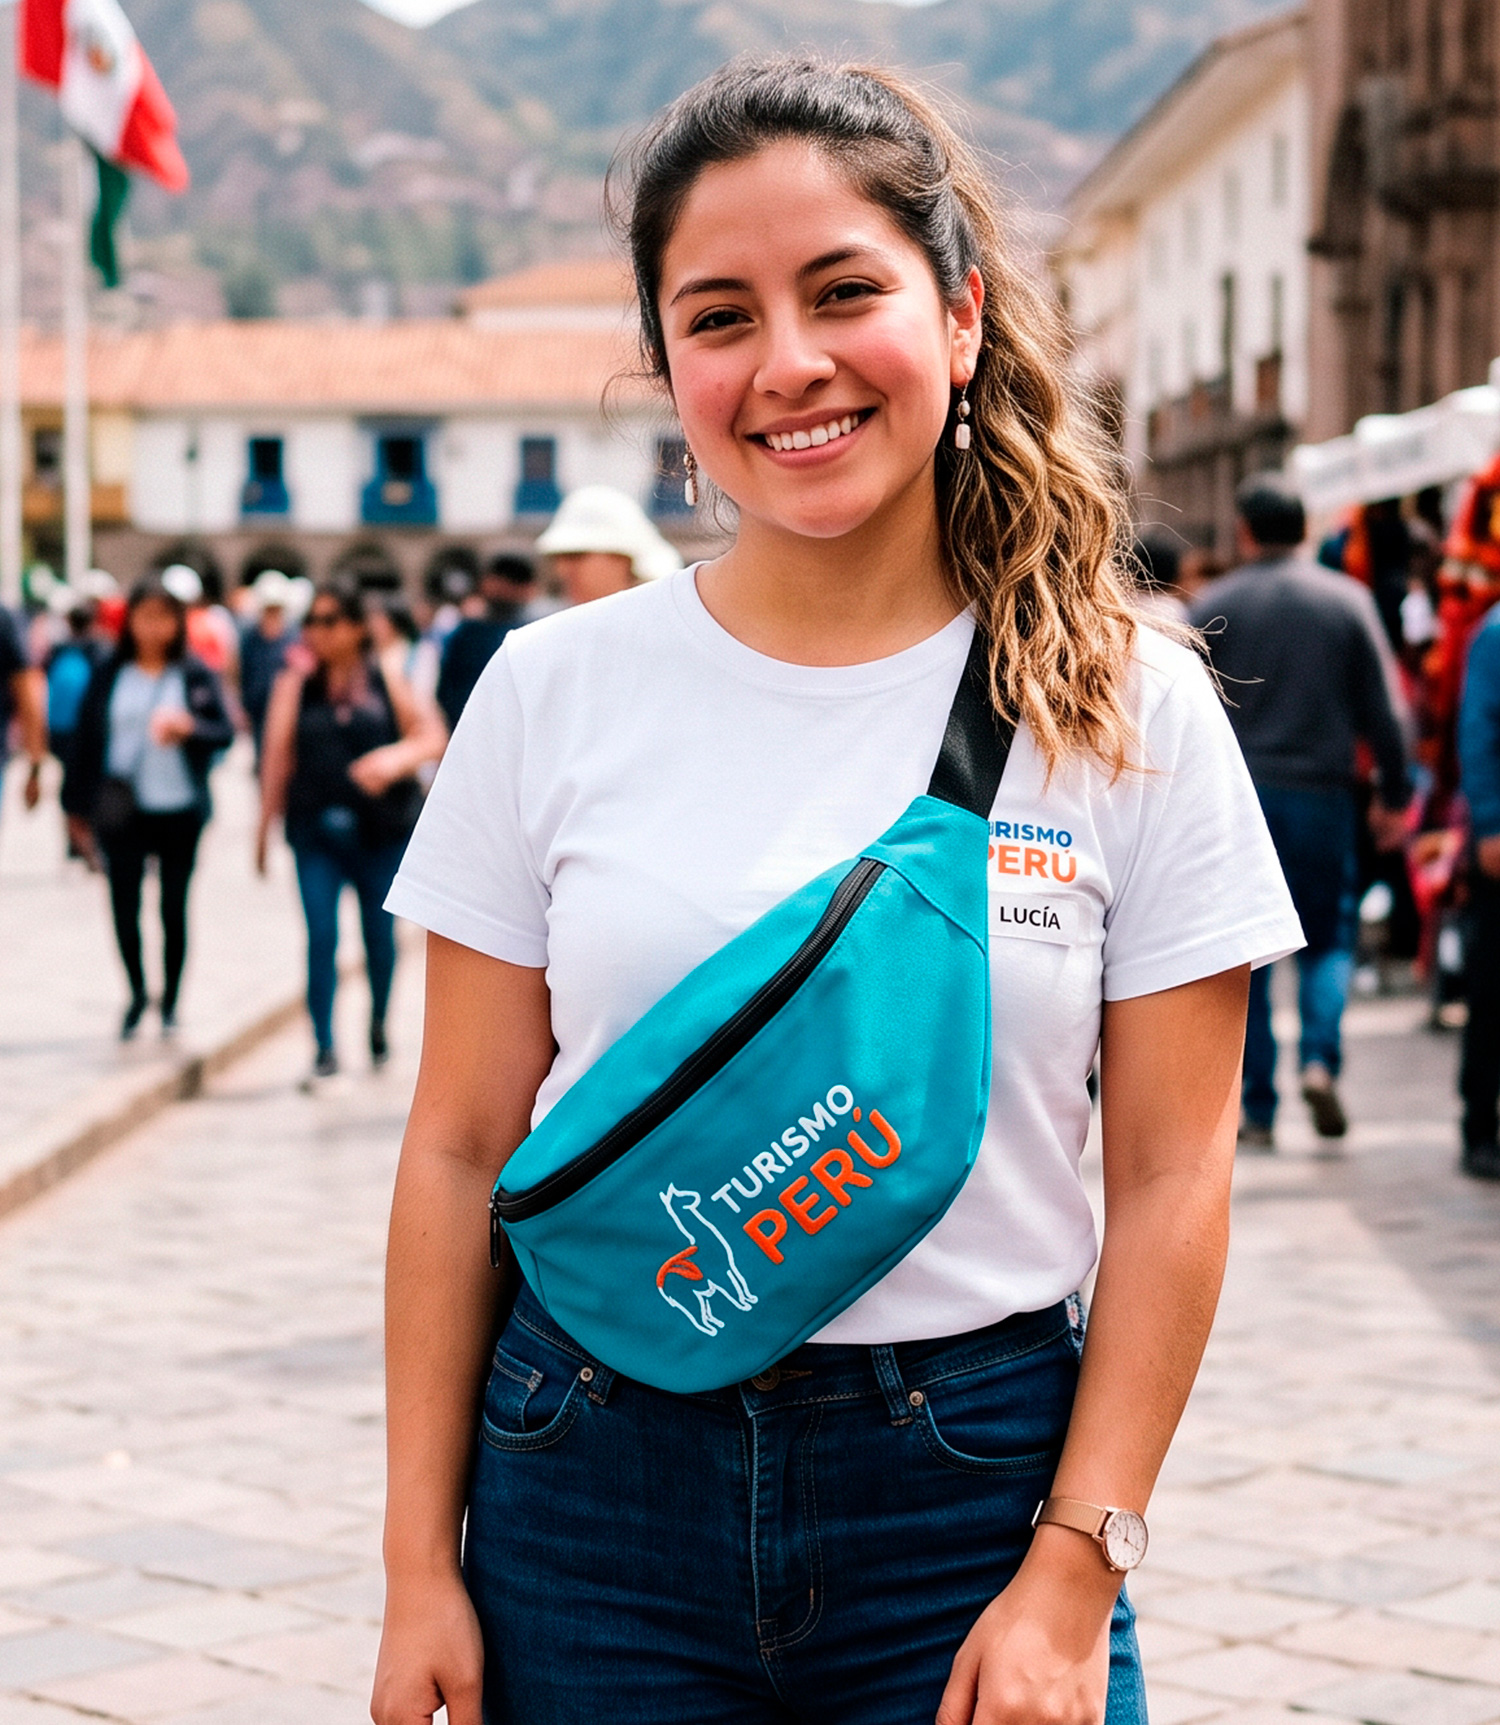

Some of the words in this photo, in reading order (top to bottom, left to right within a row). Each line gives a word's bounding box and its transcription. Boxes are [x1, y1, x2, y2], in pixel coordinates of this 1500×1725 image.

[989, 820, 1072, 848] RISMO
[988, 844, 1077, 883] ERÚ
[1000, 906, 1061, 930] LUCÍA
[710, 1084, 854, 1214] TURISMO
[742, 1106, 902, 1266] PERÚ
